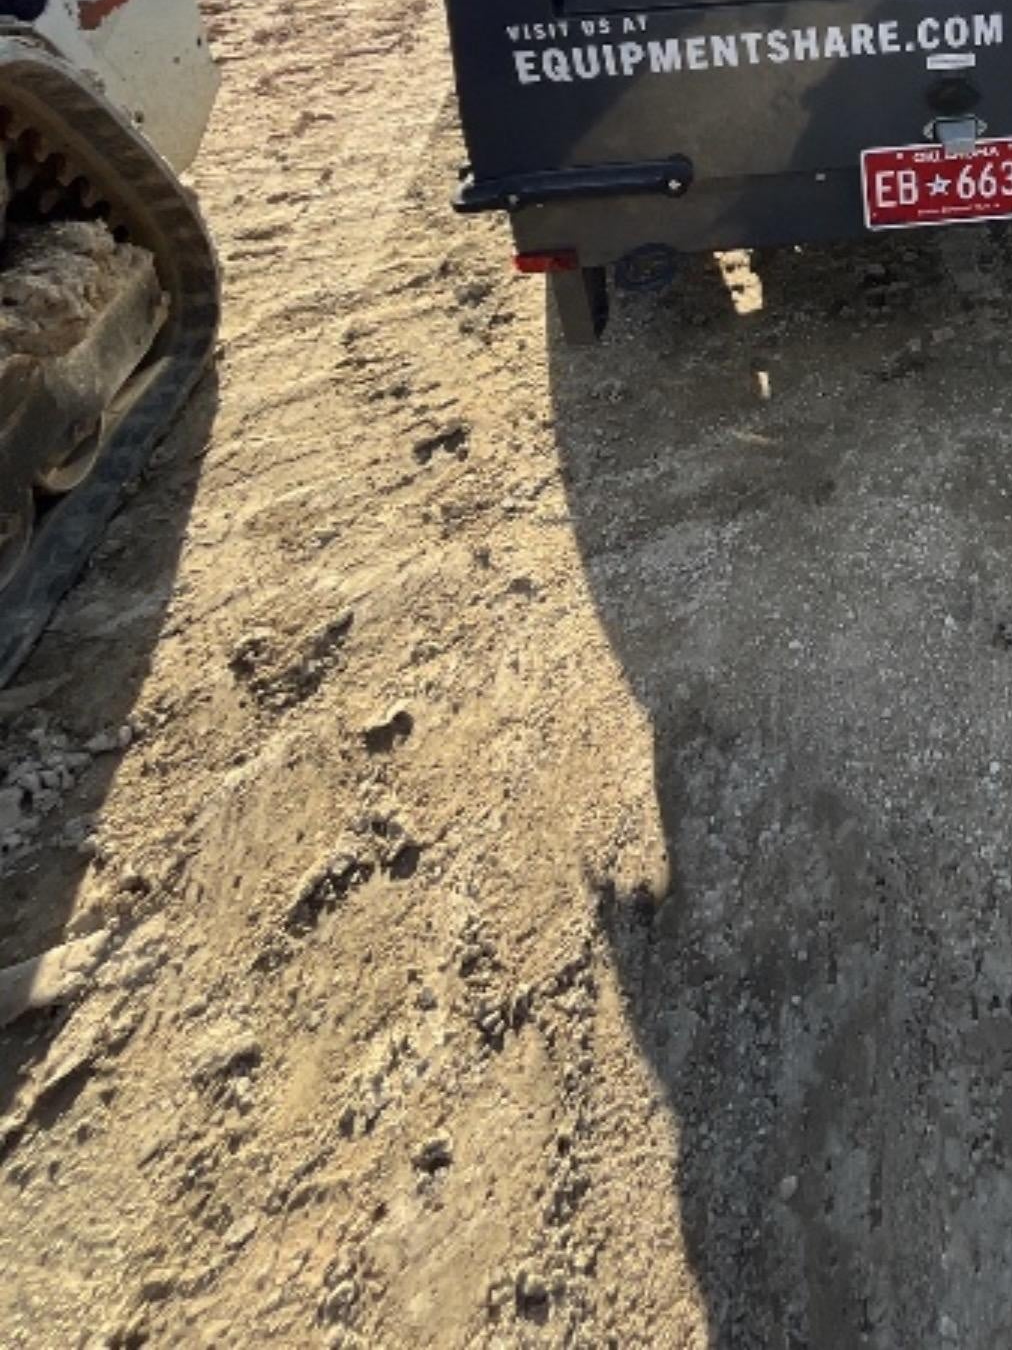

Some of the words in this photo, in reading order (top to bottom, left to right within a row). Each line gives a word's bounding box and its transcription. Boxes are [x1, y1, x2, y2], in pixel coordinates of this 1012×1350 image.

[505, 20, 569, 42] VISIT
[580, 17, 612, 37] US
[622, 14, 649, 35] AT
[511, 12, 1004, 85] EQUIPMENTSHARE.COM
[873, 169, 920, 208] EB
